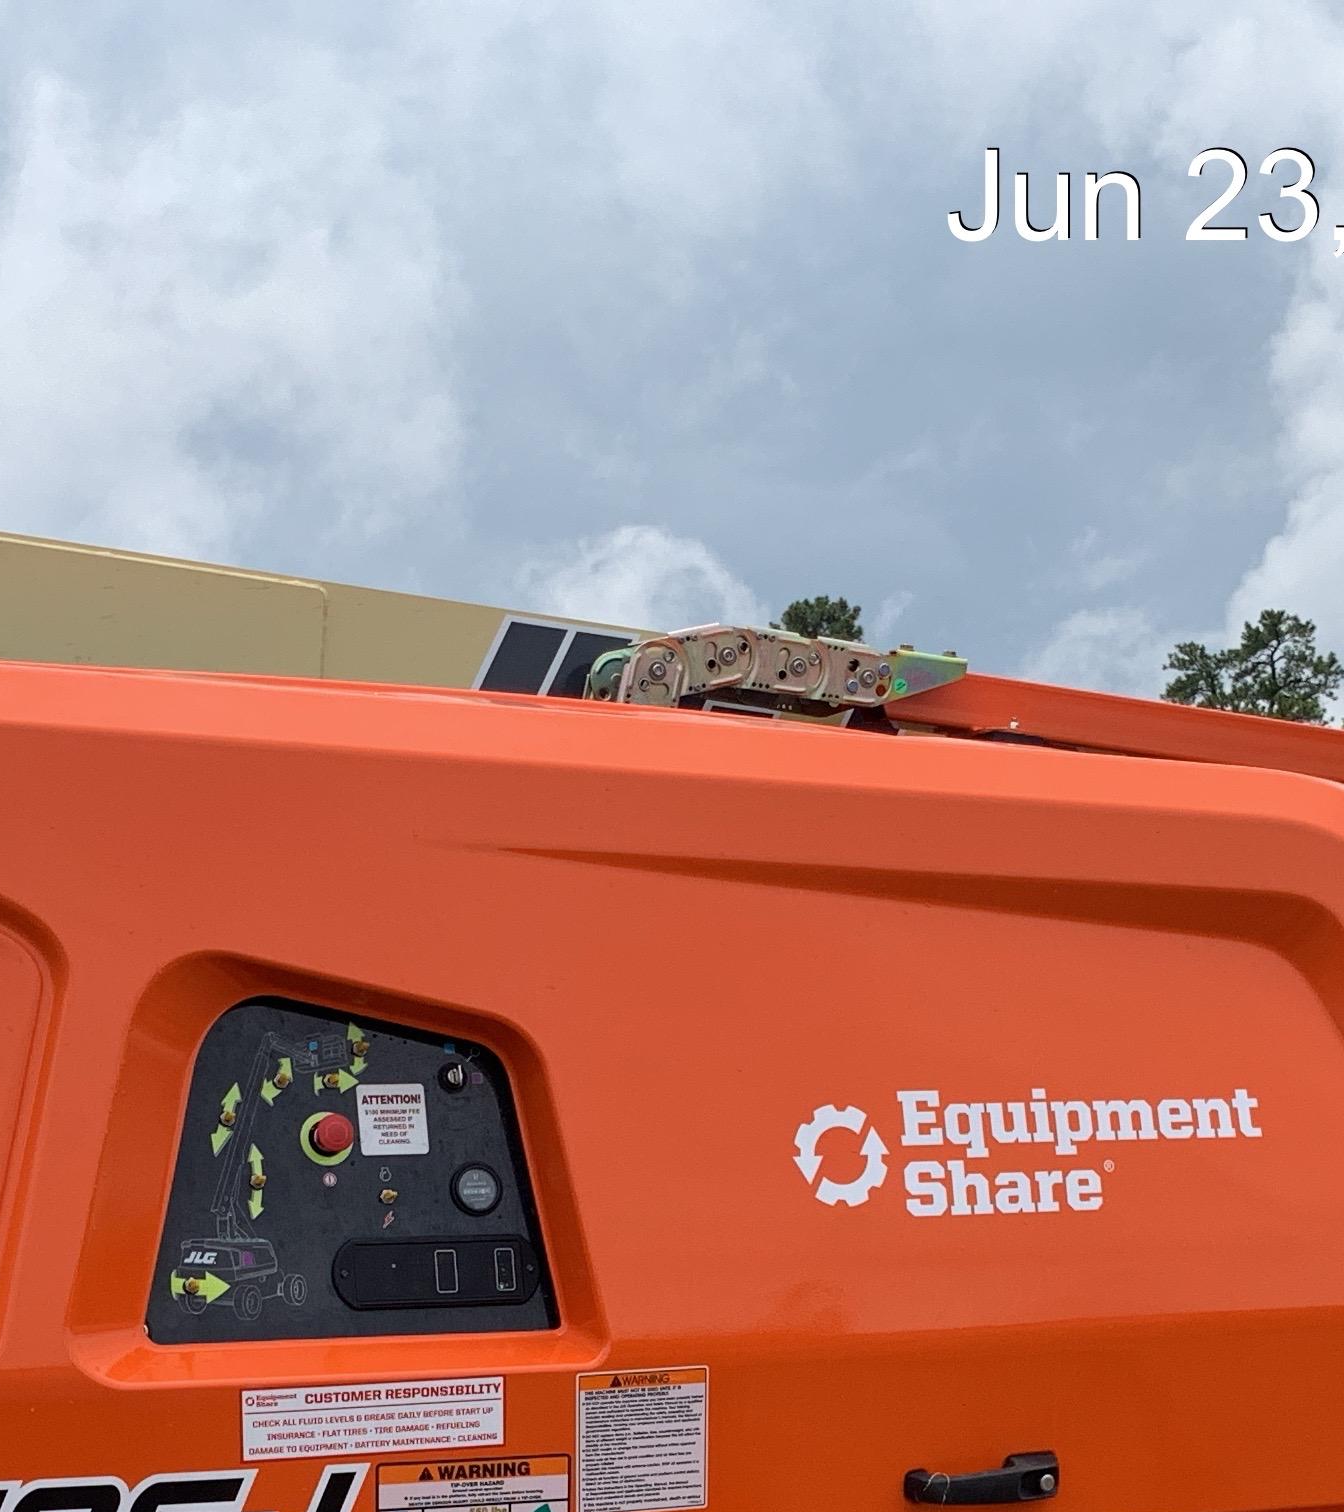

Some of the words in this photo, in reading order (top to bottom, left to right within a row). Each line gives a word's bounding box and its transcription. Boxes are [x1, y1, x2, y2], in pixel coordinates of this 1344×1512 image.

[361, 1093, 421, 1105] ATTENTION!
[896, 1088, 1263, 1158] Equipment
[902, 1159, 1104, 1217] Share
[622, 1373, 670, 1386] WARNING
[304, 1390, 382, 1404] CUSTOMER
[385, 1382, 501, 1400] RESPONSIBILITY
[252, 1420, 280, 1428] CHECK
[282, 1419, 296, 1427] ALL
[298, 1417, 323, 1425] FLUID
[325, 1415, 355, 1424] LEVELS
[364, 1413, 396, 1421] GREASE
[397, 1411, 422, 1419] DAILY
[423, 1409, 454, 1418] BEFORE
[455, 1407, 481, 1416] START
[267, 1431, 315, 1441] INSURANCE
[322, 1429, 343, 1438] FLAT
[343, 1428, 368, 1436] TIRES
[374, 1426, 394, 1434] TIRE
[395, 1423, 429, 1433] DAMAGE
[436, 1420, 481, 1430] REFUELING
[249, 1447, 285, 1455] DAMAGE
[286, 1445, 297, 1453] TO
[299, 1442, 348, 1453] EQUIPMENT
[354, 1439, 391, 1449] BATTERY
[392, 1436, 452, 1446] MAINTENANCE
[457, 1432, 498, 1442] CLEANING
[437, 1461, 531, 1480] WARNING
